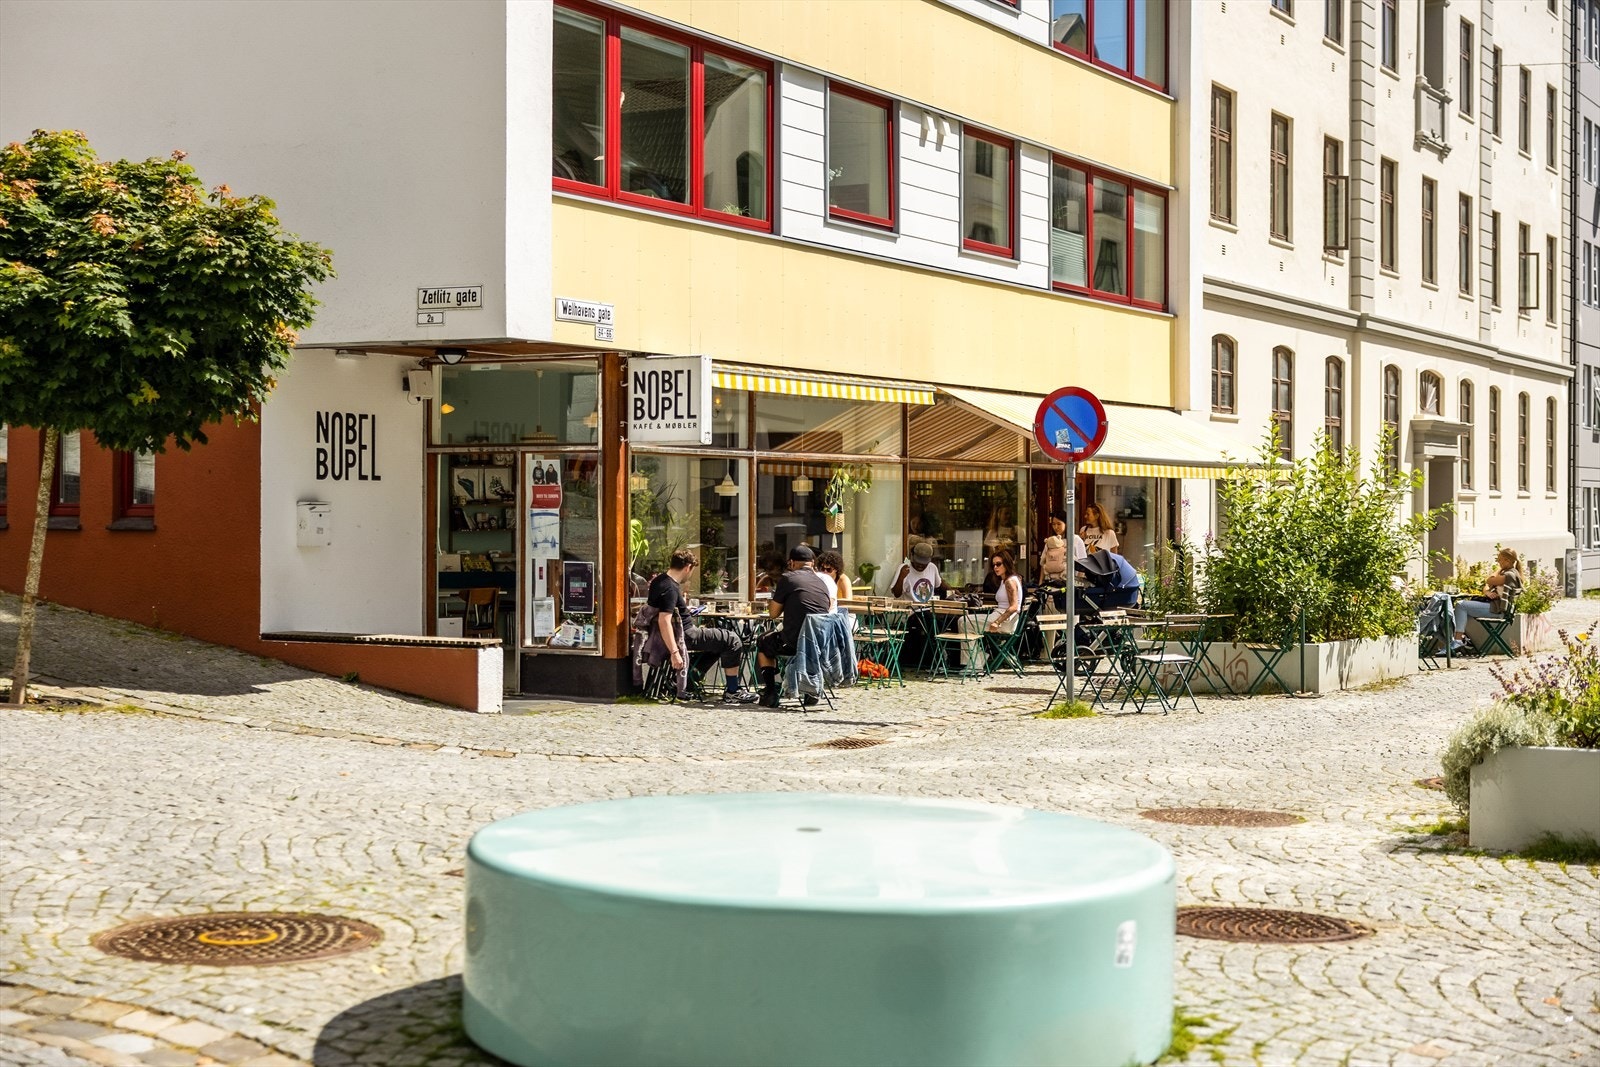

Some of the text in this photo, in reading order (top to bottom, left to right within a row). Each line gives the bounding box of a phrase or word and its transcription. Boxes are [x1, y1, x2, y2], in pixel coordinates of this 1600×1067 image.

[422, 289, 477, 306] Zetlitz gate
[562, 300, 611, 322] Welhavens gate
